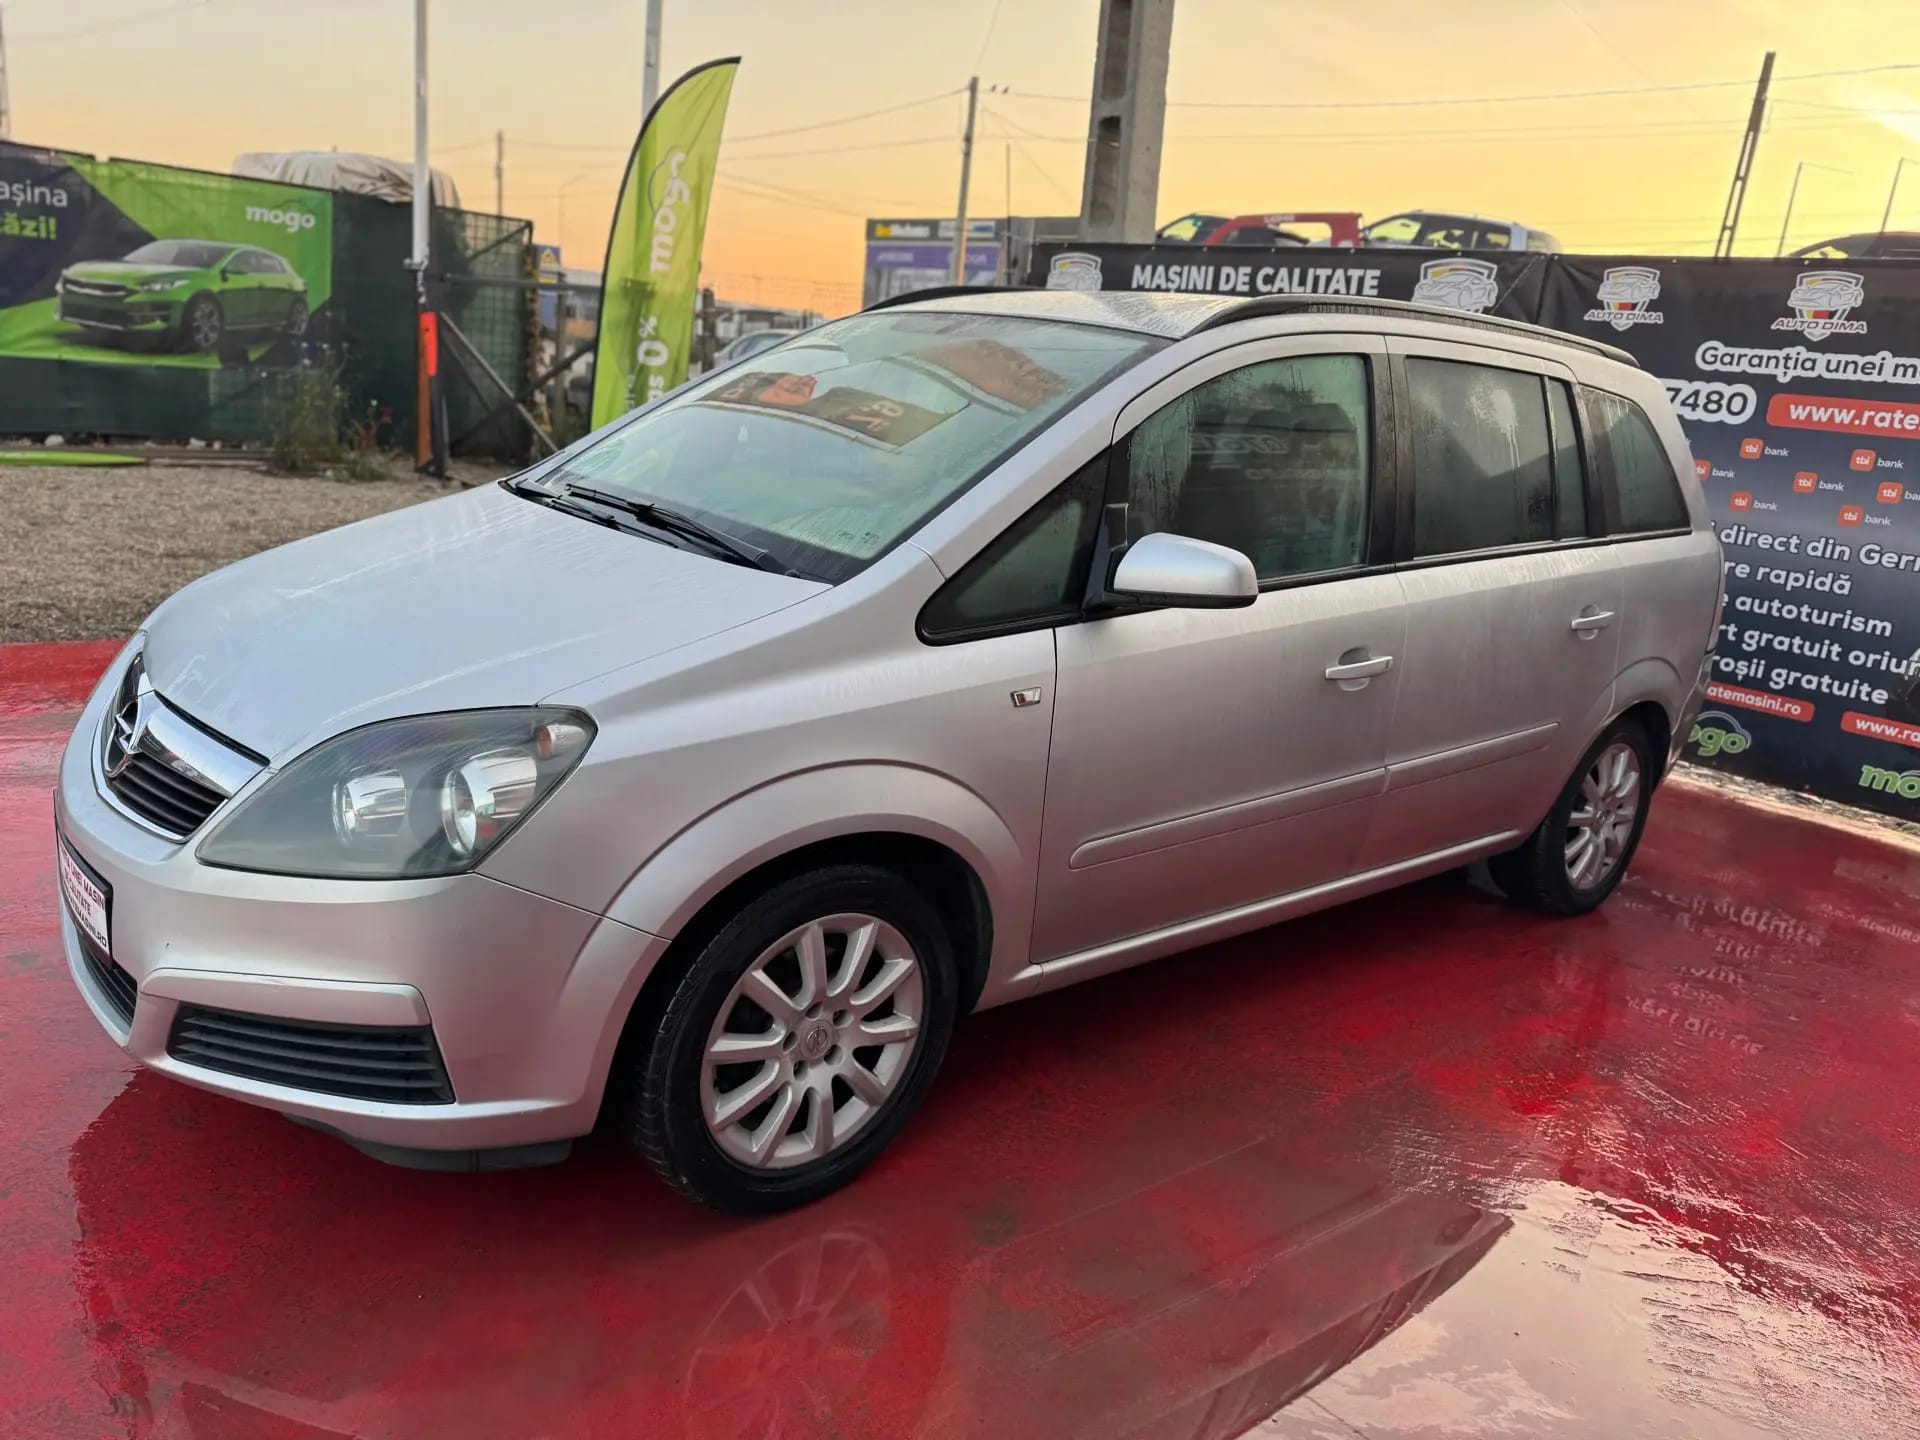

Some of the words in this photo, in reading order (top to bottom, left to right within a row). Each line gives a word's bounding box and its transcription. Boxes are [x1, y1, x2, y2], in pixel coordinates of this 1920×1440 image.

[0, 211, 57, 240] ăzi!
[245, 205, 316, 233] mogo
[1218, 267, 1250, 293] DE
[1256, 267, 1381, 297] CALITATE
[1584, 310, 1625, 321] AUTO
[1625, 311, 1663, 323] DIMA
[1772, 318, 1821, 331] AUTO
[1821, 320, 1867, 333] DIMA
[1701, 346, 1818, 377] Garanția
[1825, 356, 1886, 376] unei
[1892, 363, 1920, 379] m
[1789, 403, 1920, 430] www.rate
[1744, 443, 1760, 454] tbi
[1764, 445, 1789, 457] bank
[1855, 456, 1870, 466] tbi
[1877, 457, 1904, 469] bank
[1711, 466, 1736, 478] bank
[1798, 478, 1813, 488] tbi
[1818, 480, 1845, 492] bank
[1734, 497, 1748, 507] tbi
[1753, 500, 1778, 511] bank
[1882, 488, 1898, 498] tbi
[1904, 491, 1920, 502] ba
[1842, 512, 1858, 521] tbi
[1864, 514, 1891, 526] bank
[1720, 525, 1800, 553] direct
[1806, 538, 1851, 561] din
[1756, 566, 1852, 596] rapidă
[1735, 594, 1893, 637] autoturism
[1742, 630, 1842, 662] gratuit
[1769, 667, 1889, 705] gratuite
